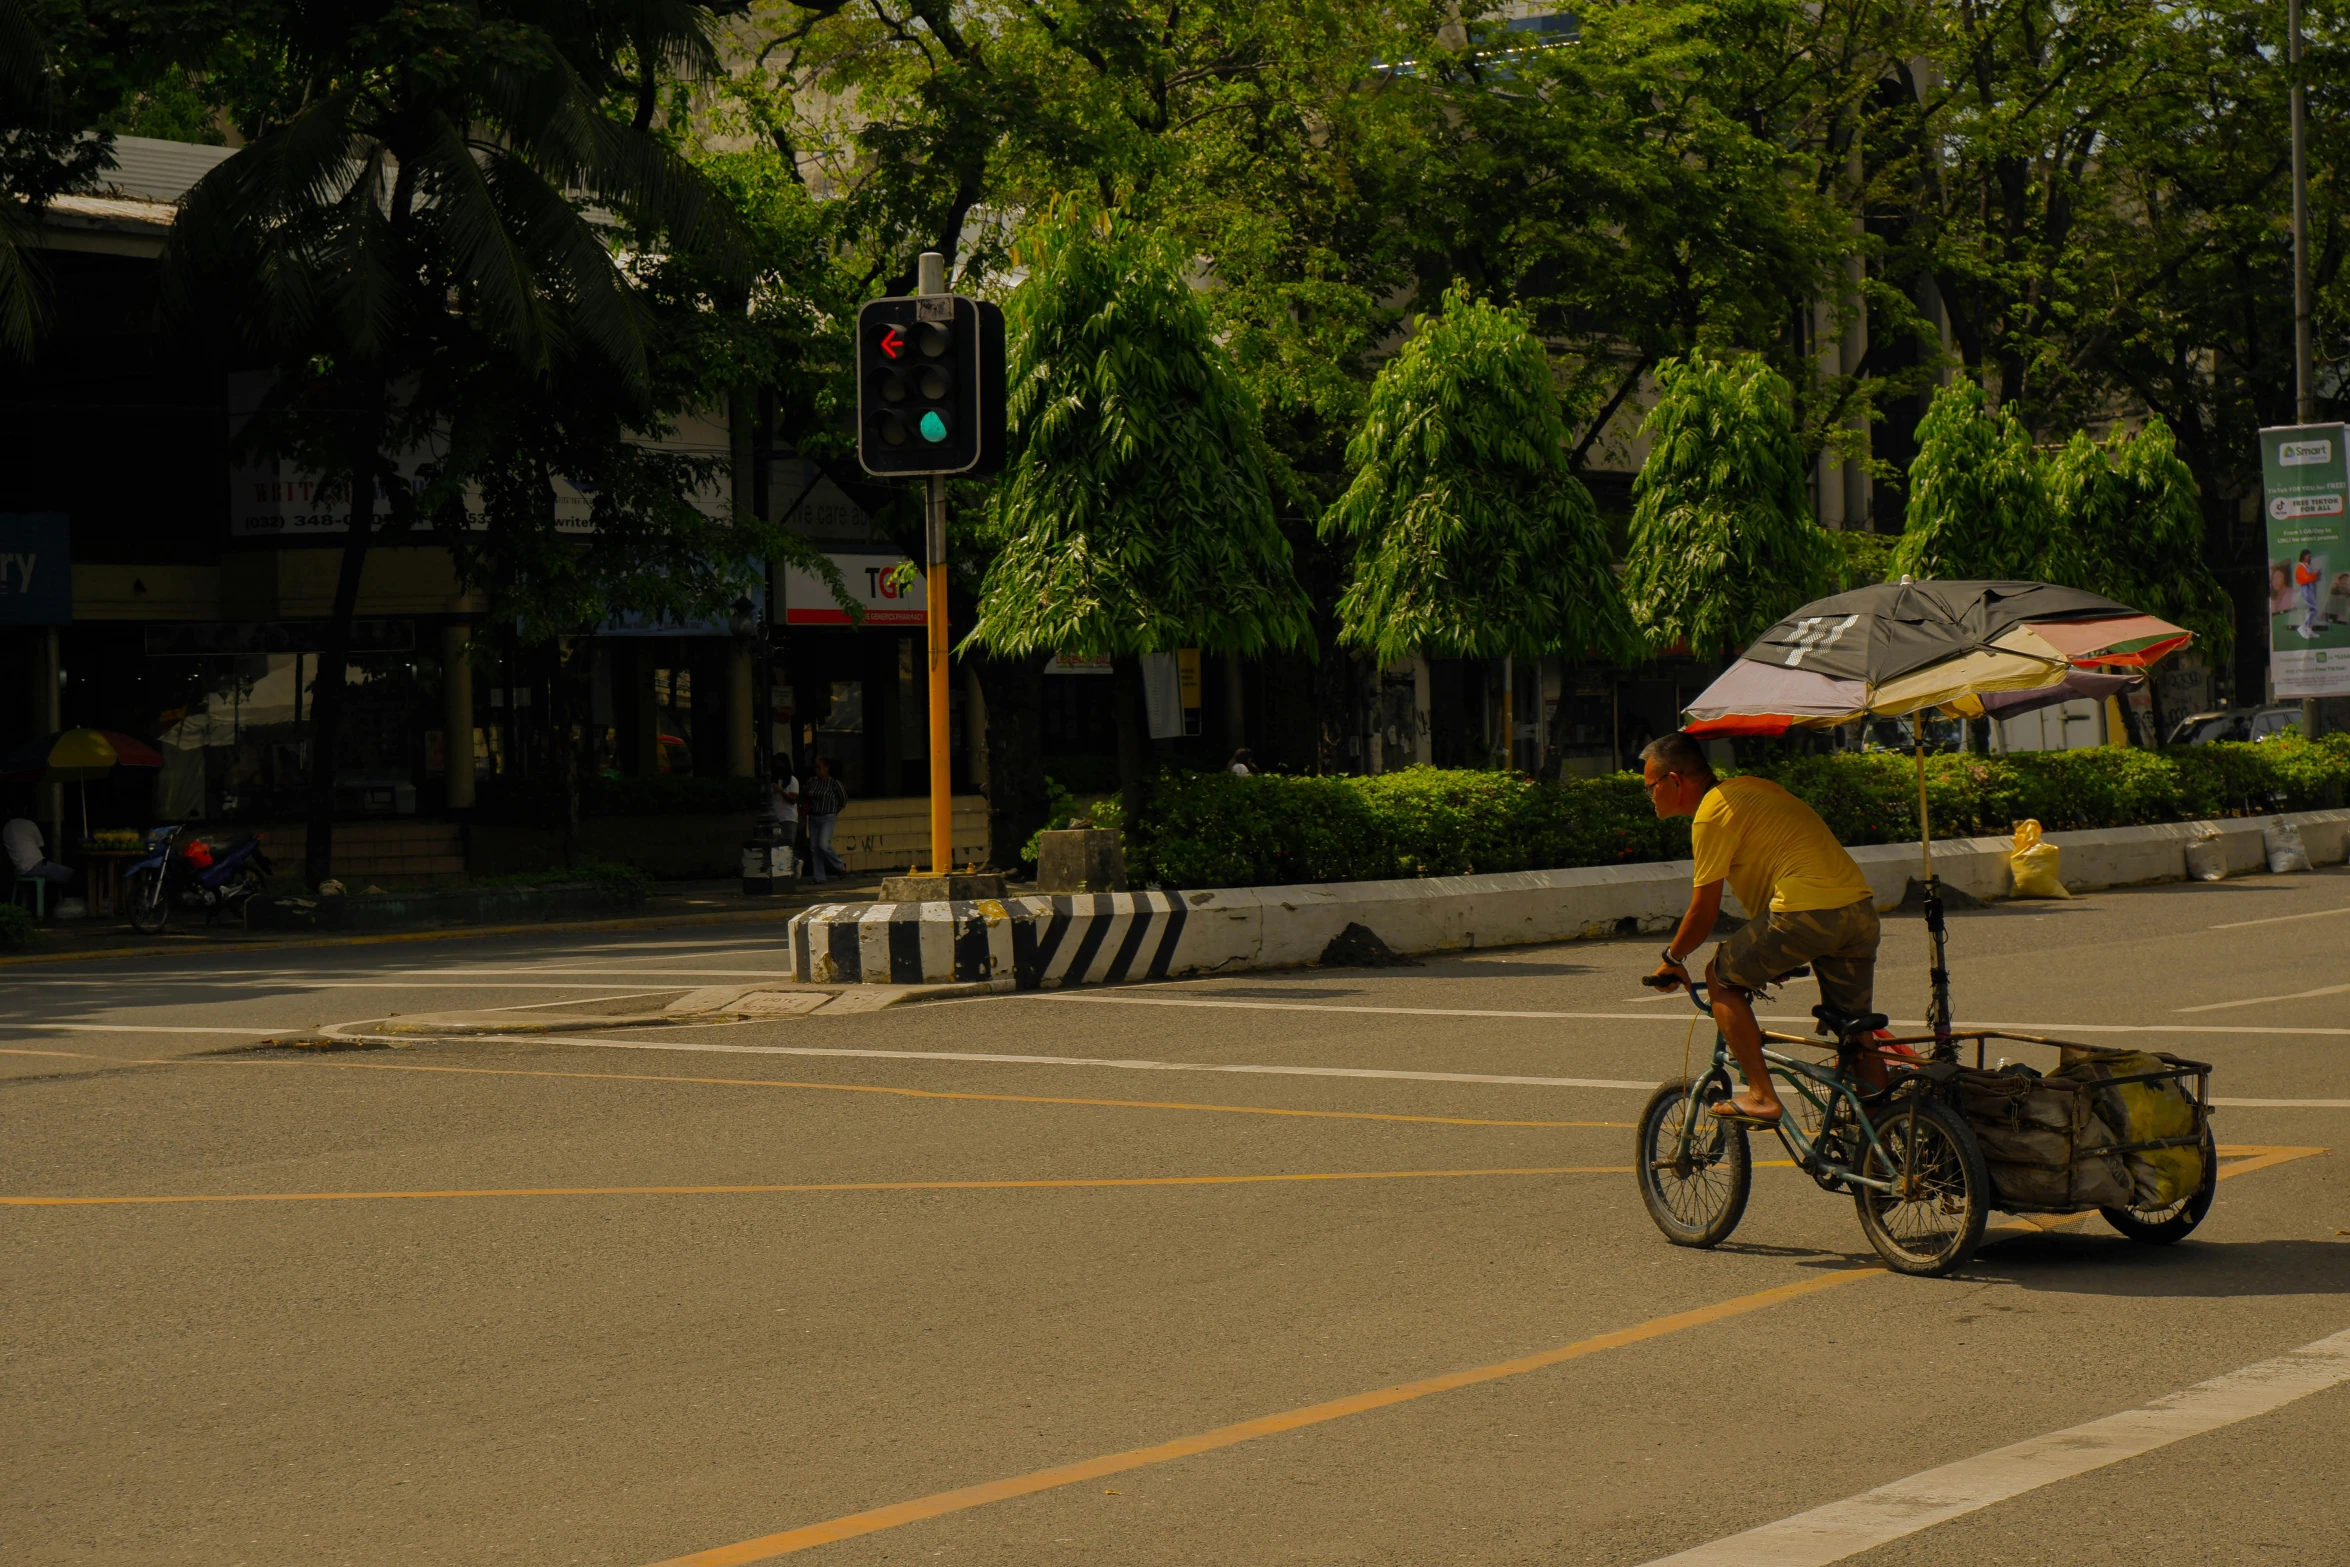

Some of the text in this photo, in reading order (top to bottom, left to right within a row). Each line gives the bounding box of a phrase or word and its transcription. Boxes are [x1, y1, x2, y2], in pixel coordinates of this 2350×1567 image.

[2296, 444, 2327, 456] Smart
[817, 504, 847, 525] care
[245, 516, 285, 529] (032)
[896, 613, 924, 621] PHARMACY
